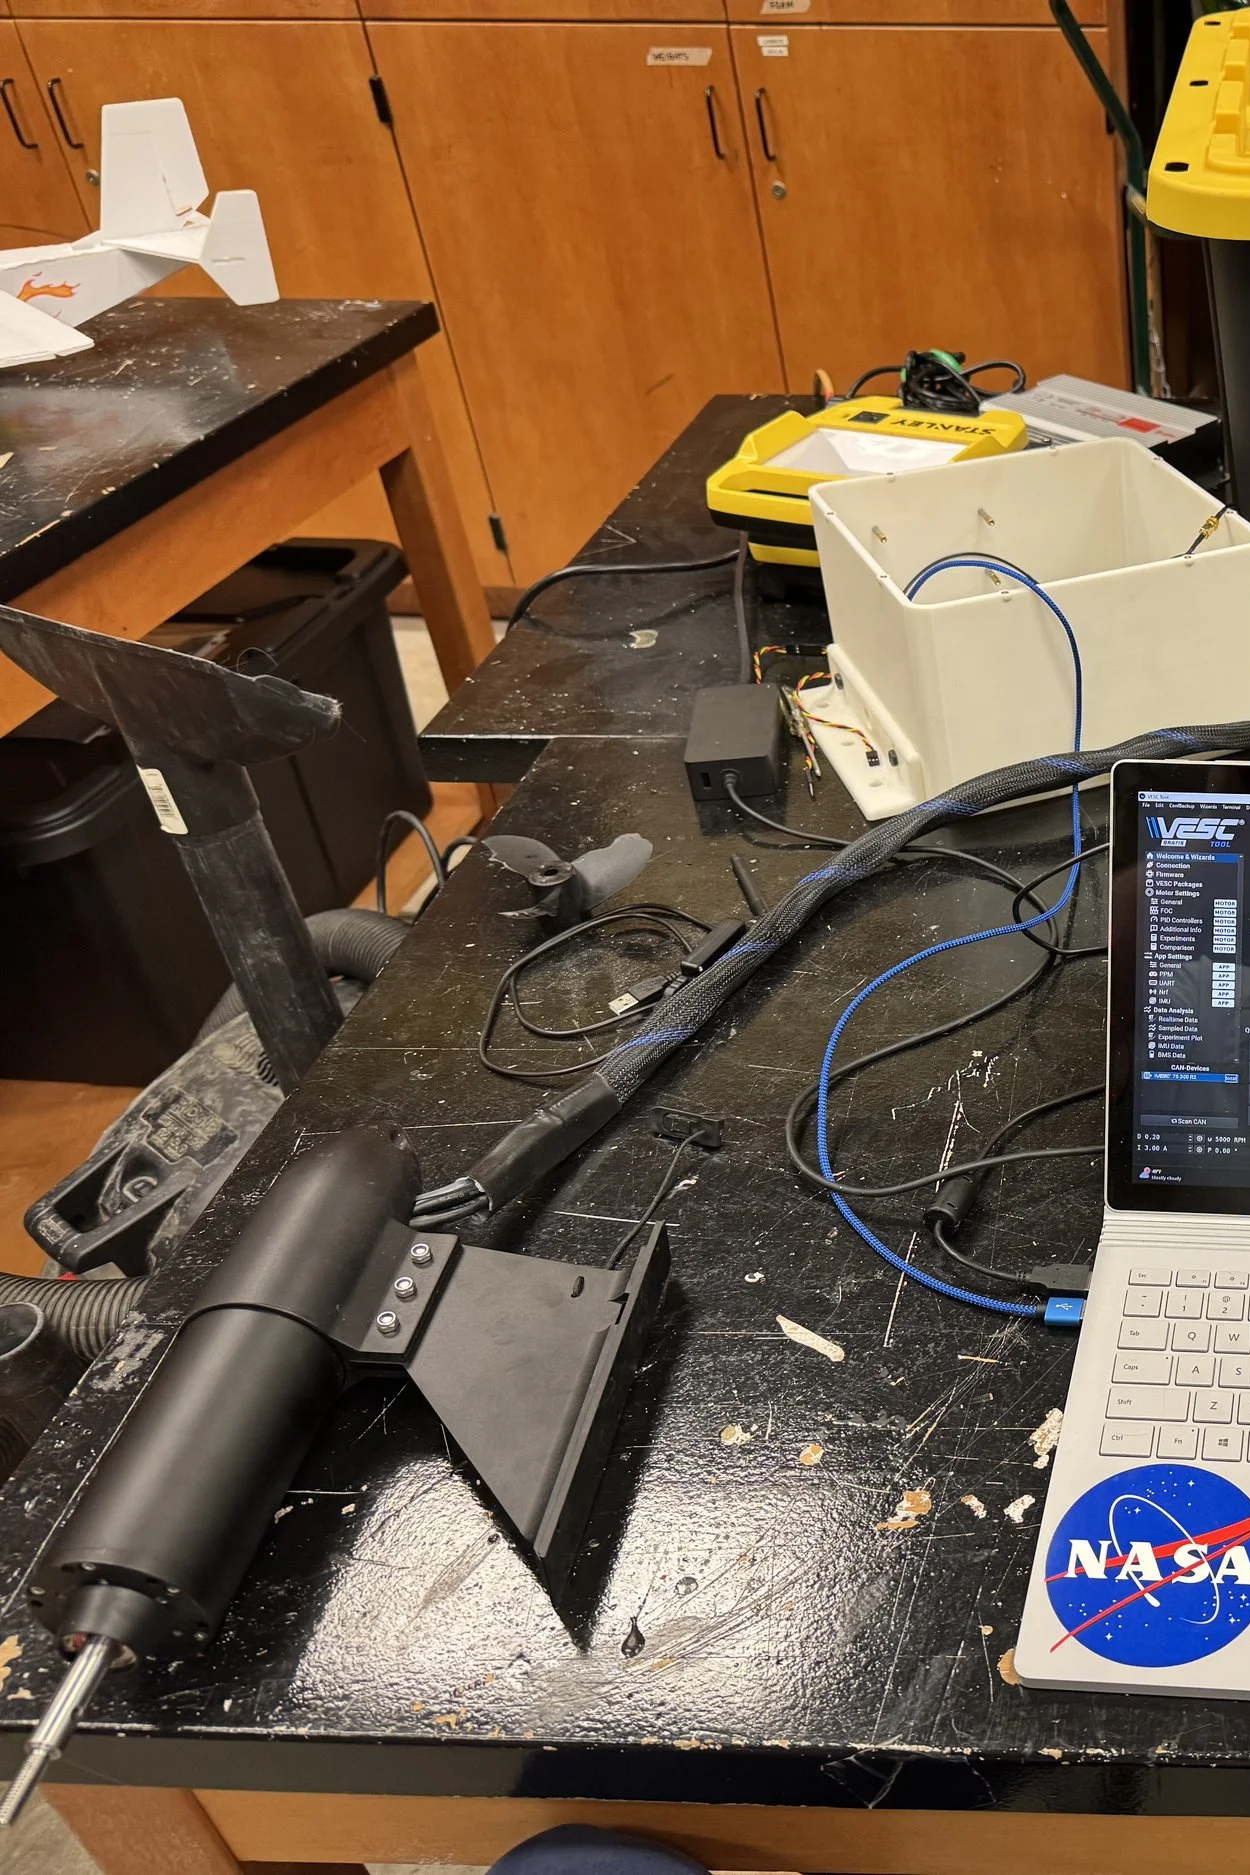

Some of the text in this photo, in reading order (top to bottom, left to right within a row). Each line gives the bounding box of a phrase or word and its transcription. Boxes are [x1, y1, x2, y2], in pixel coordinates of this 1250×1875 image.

[891, 419, 996, 435] STANLEY
[1169, 1007, 1193, 1015] Analysis
[1171, 1064, 1210, 1072] CAN-Devices
[1117, 1398, 1132, 1406] Shift
